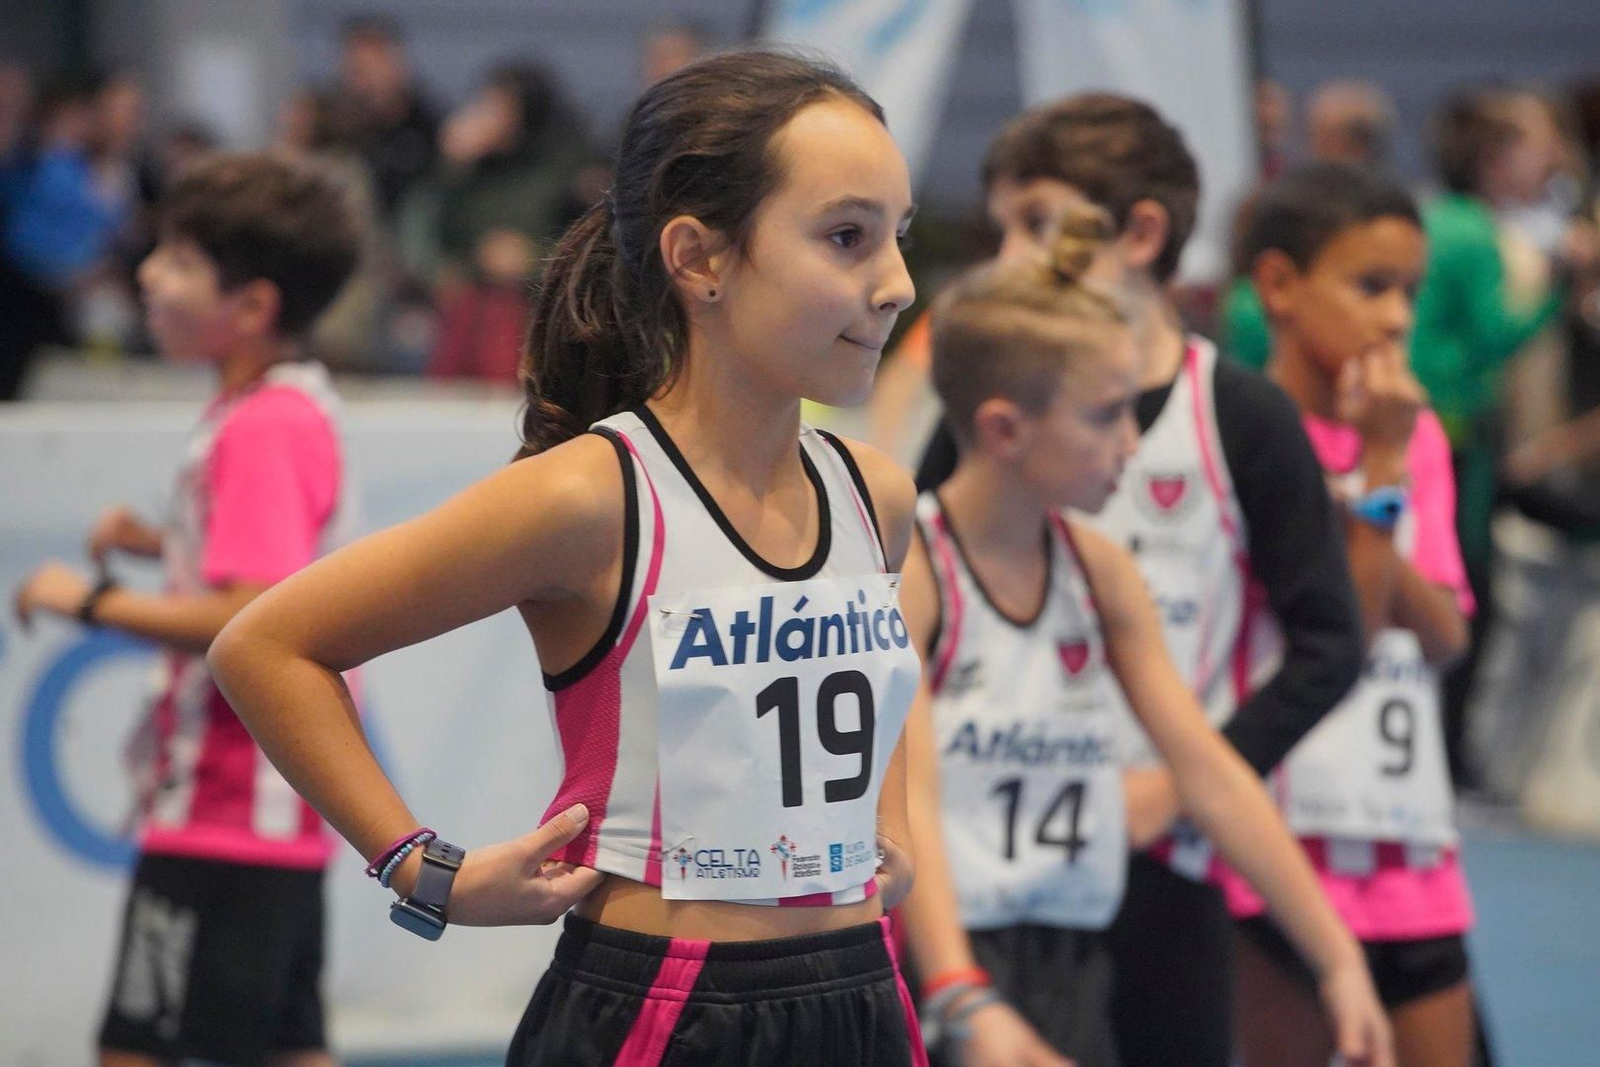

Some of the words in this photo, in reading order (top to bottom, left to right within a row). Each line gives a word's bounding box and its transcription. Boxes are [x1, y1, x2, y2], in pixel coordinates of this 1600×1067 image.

[669, 589, 909, 670] Atlántico
[755, 669, 875, 808] 19
[1378, 697, 1416, 778] 9
[694, 849, 761, 867] CELTA
[989, 776, 1088, 866] 14
[695, 867, 761, 879] ATLETISMO
